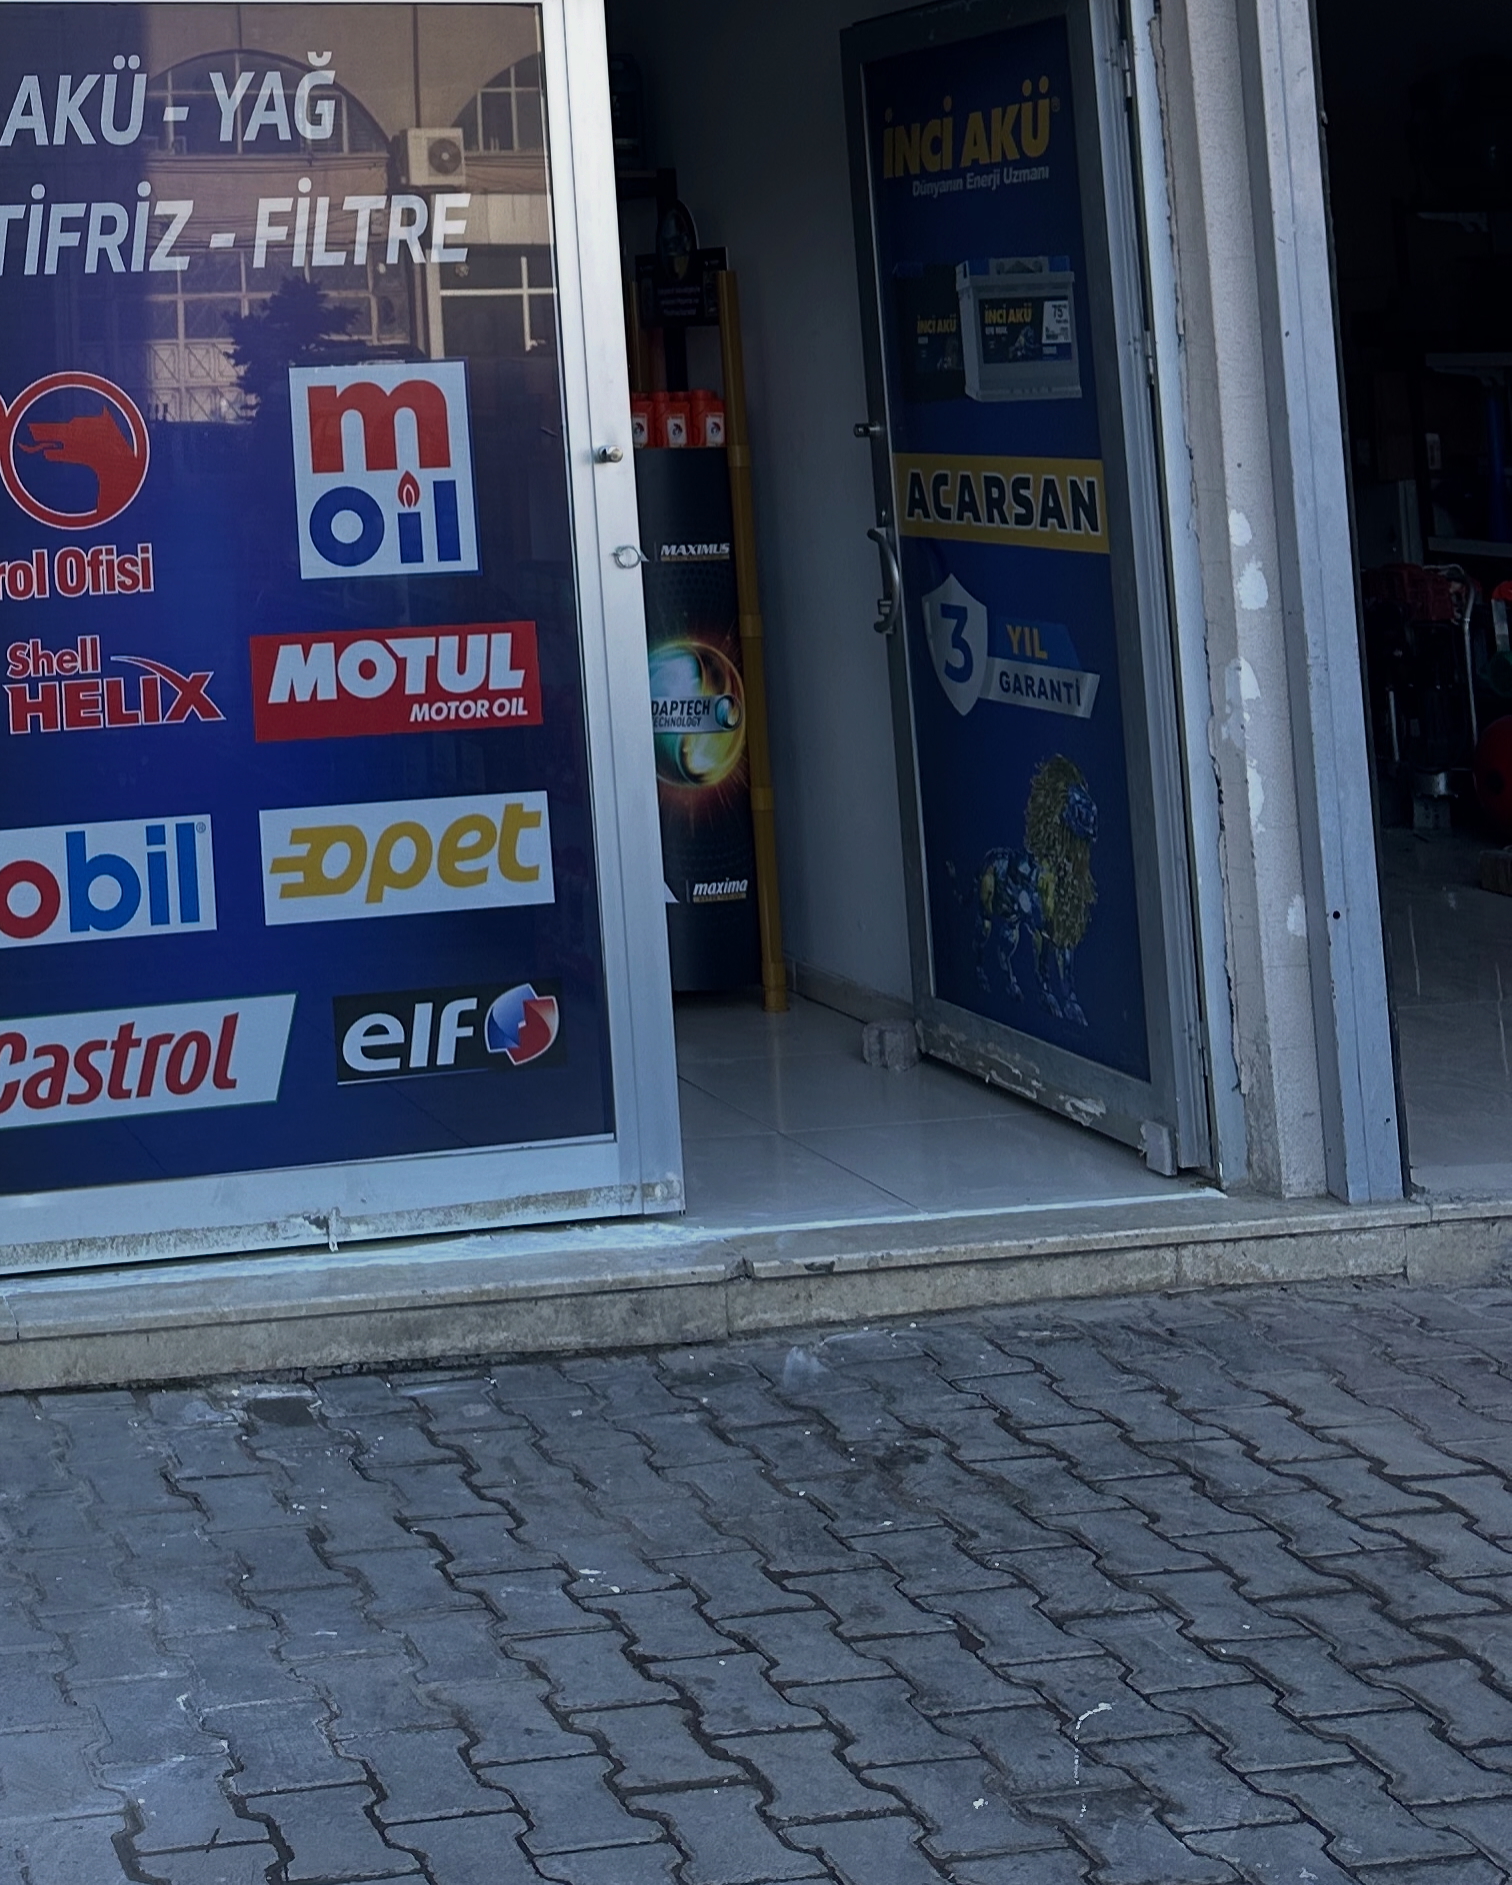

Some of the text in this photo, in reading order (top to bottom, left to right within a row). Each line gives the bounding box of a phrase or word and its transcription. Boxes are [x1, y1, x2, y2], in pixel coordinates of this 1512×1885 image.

[0, 54, 148, 147] AKÜ
[208, 50, 337, 142] YAĞ
[883, 95, 954, 180] İNCİ
[912, 165, 1050, 199] Dünyanın Enerji Uzmanı
[251, 176, 471, 269] FİLTRE
[905, 468, 1103, 536] ACARSAN
[56, 543, 155, 596] Ofisi
[660, 542, 730, 556] MAXIMUS
[6, 635, 101, 678] Shell
[267, 632, 528, 705] MOTUL
[940, 603, 975, 684] 3
[1005, 623, 1048, 660] YIL
[4, 656, 226, 735] HELIX
[409, 696, 529, 723] MOTOR OIL
[998, 668, 1081, 707] GARANTİ
[269, 801, 542, 904] opet
[693, 877, 749, 896] maxima
[341, 997, 479, 1074] elf
